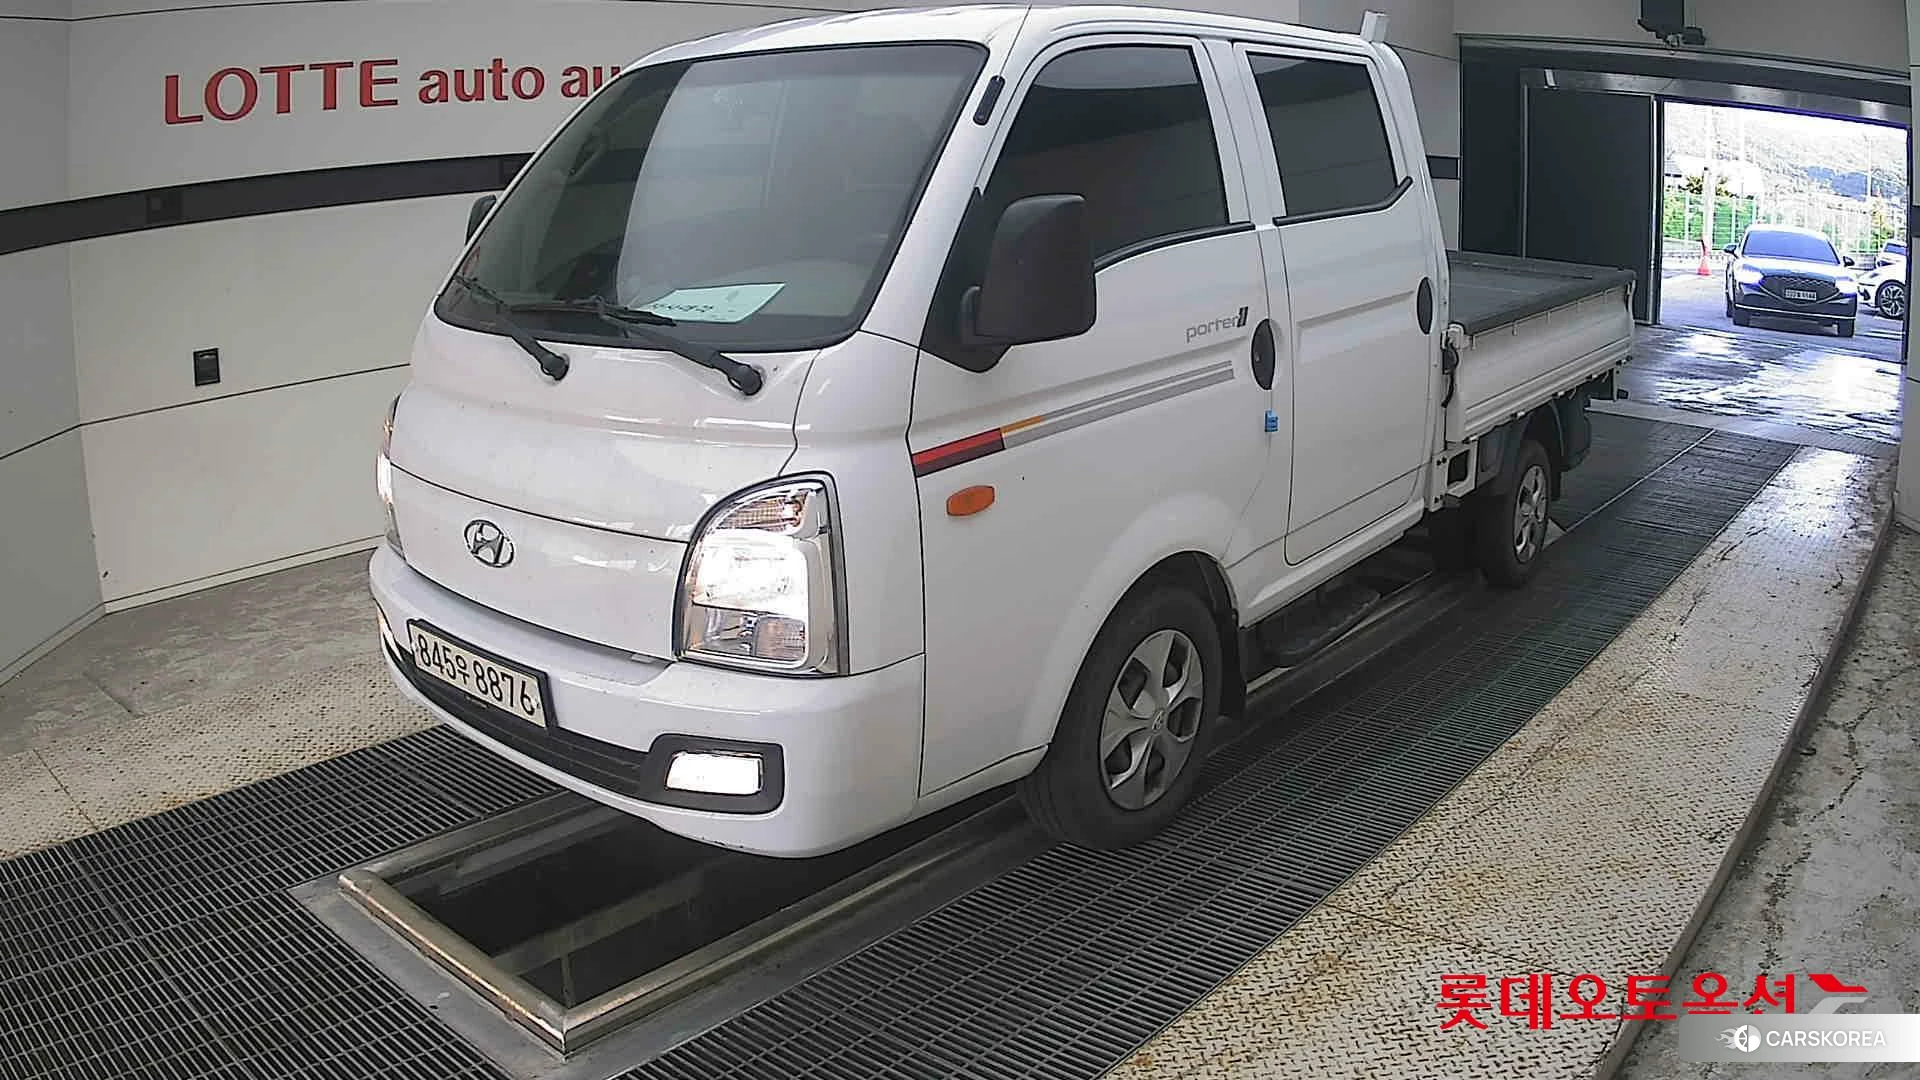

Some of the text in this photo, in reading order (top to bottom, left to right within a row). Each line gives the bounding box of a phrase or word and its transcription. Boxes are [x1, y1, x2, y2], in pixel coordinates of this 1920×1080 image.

[164, 59, 398, 124] LOTTE
[418, 58, 545, 103] auto
[417, 634, 535, 717] 845우 8876
